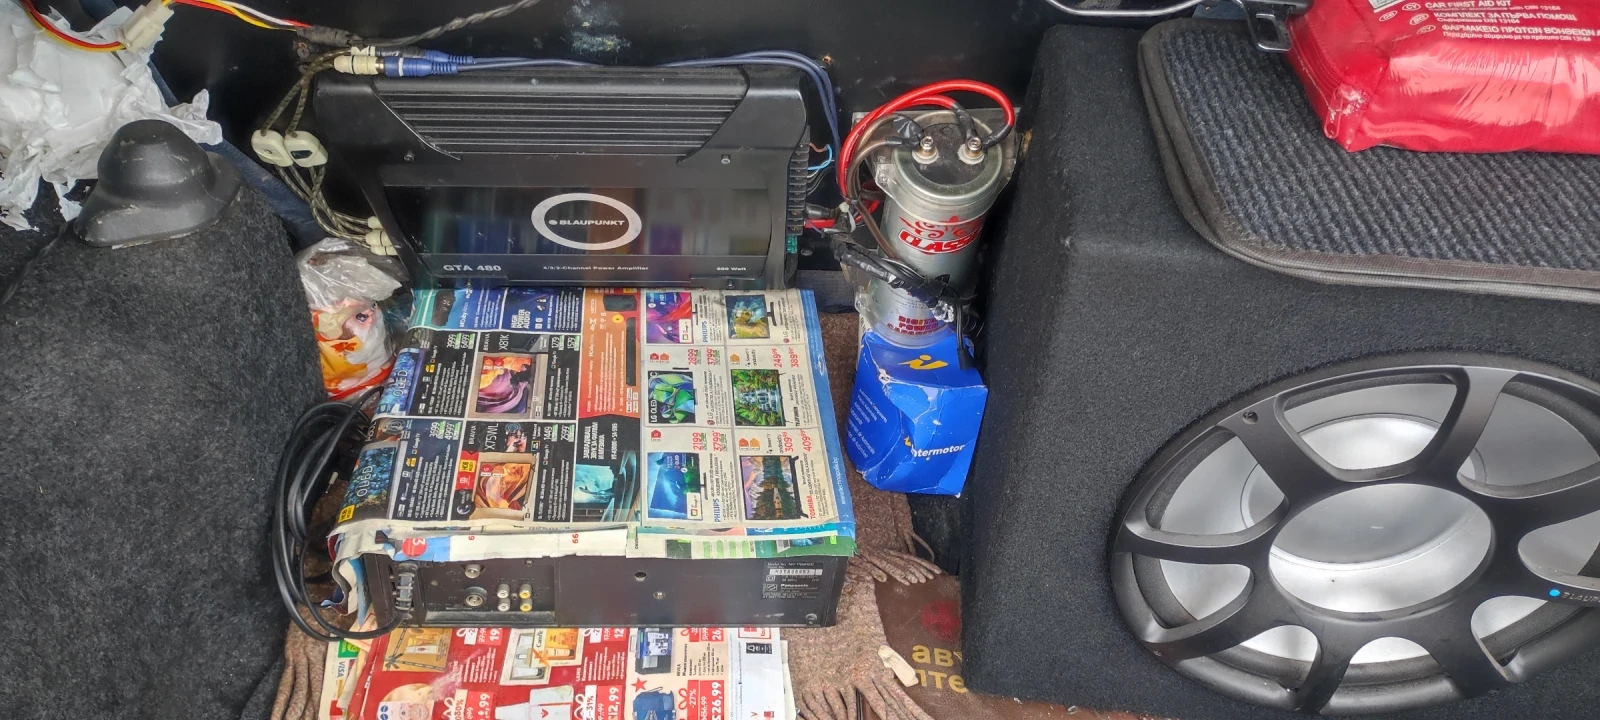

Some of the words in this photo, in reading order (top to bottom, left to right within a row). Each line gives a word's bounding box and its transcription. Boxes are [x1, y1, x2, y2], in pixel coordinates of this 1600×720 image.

[1537, 13, 1577, 21] ПОМОЩ
[1501, 26, 1542, 34] ΠΡΩΤΩΝ
[523, 311, 531, 329] AUDIO
[701, 321, 709, 343] PHILIPS
[498, 334, 509, 351] X81K
[651, 414, 658, 423] LG
[468, 425, 477, 445] BRAVIA
[484, 423, 499, 451] X75WL
[692, 432, 703, 451] 2199
[712, 498, 721, 523] PHILIPS
[806, 496, 817, 520] TOSHIBA
[336, 661, 346, 678] VISA
[689, 688, 697, 709] -27%
[711, 681, 723, 714] 26,99
